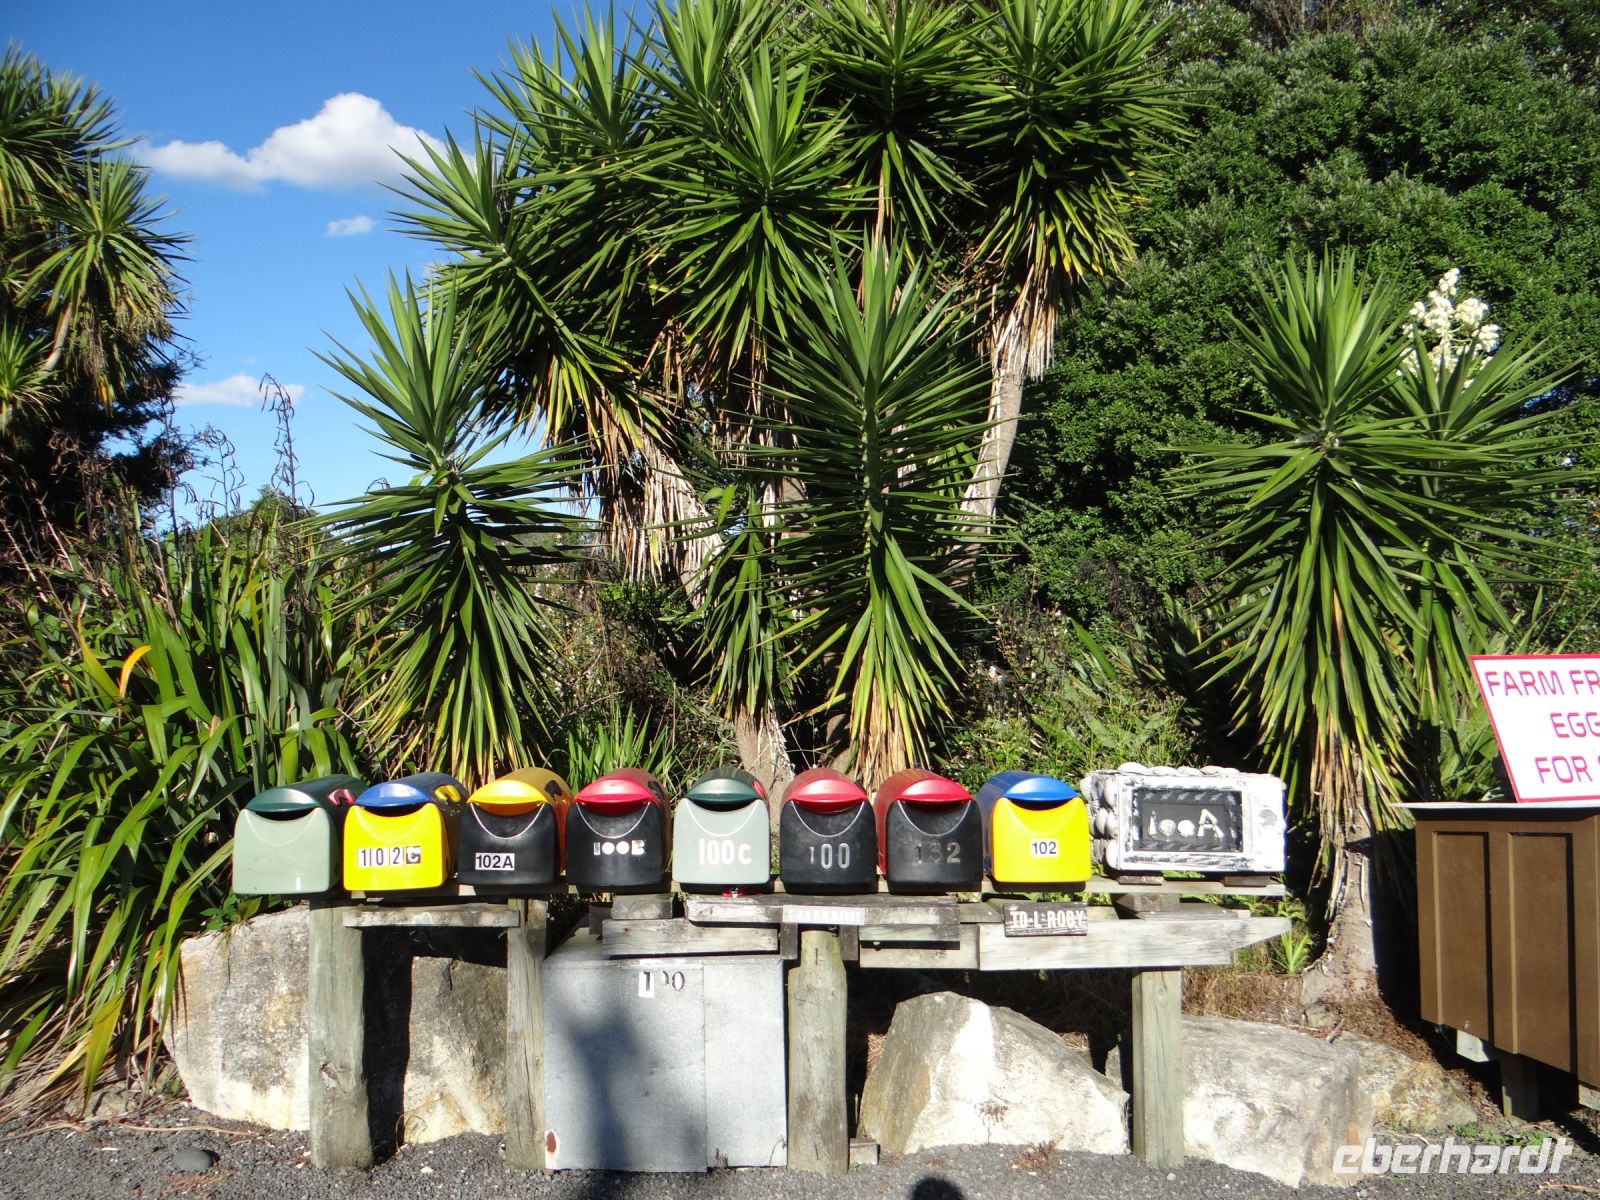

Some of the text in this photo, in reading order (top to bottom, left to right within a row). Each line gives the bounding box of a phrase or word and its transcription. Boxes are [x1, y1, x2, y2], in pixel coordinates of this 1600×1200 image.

[1484, 670, 1565, 697] FARM
[1534, 755, 1593, 784] FOR
[809, 843, 850, 869] 100
[1031, 841, 1057, 855] 102
[476, 854, 514, 869] 102A
